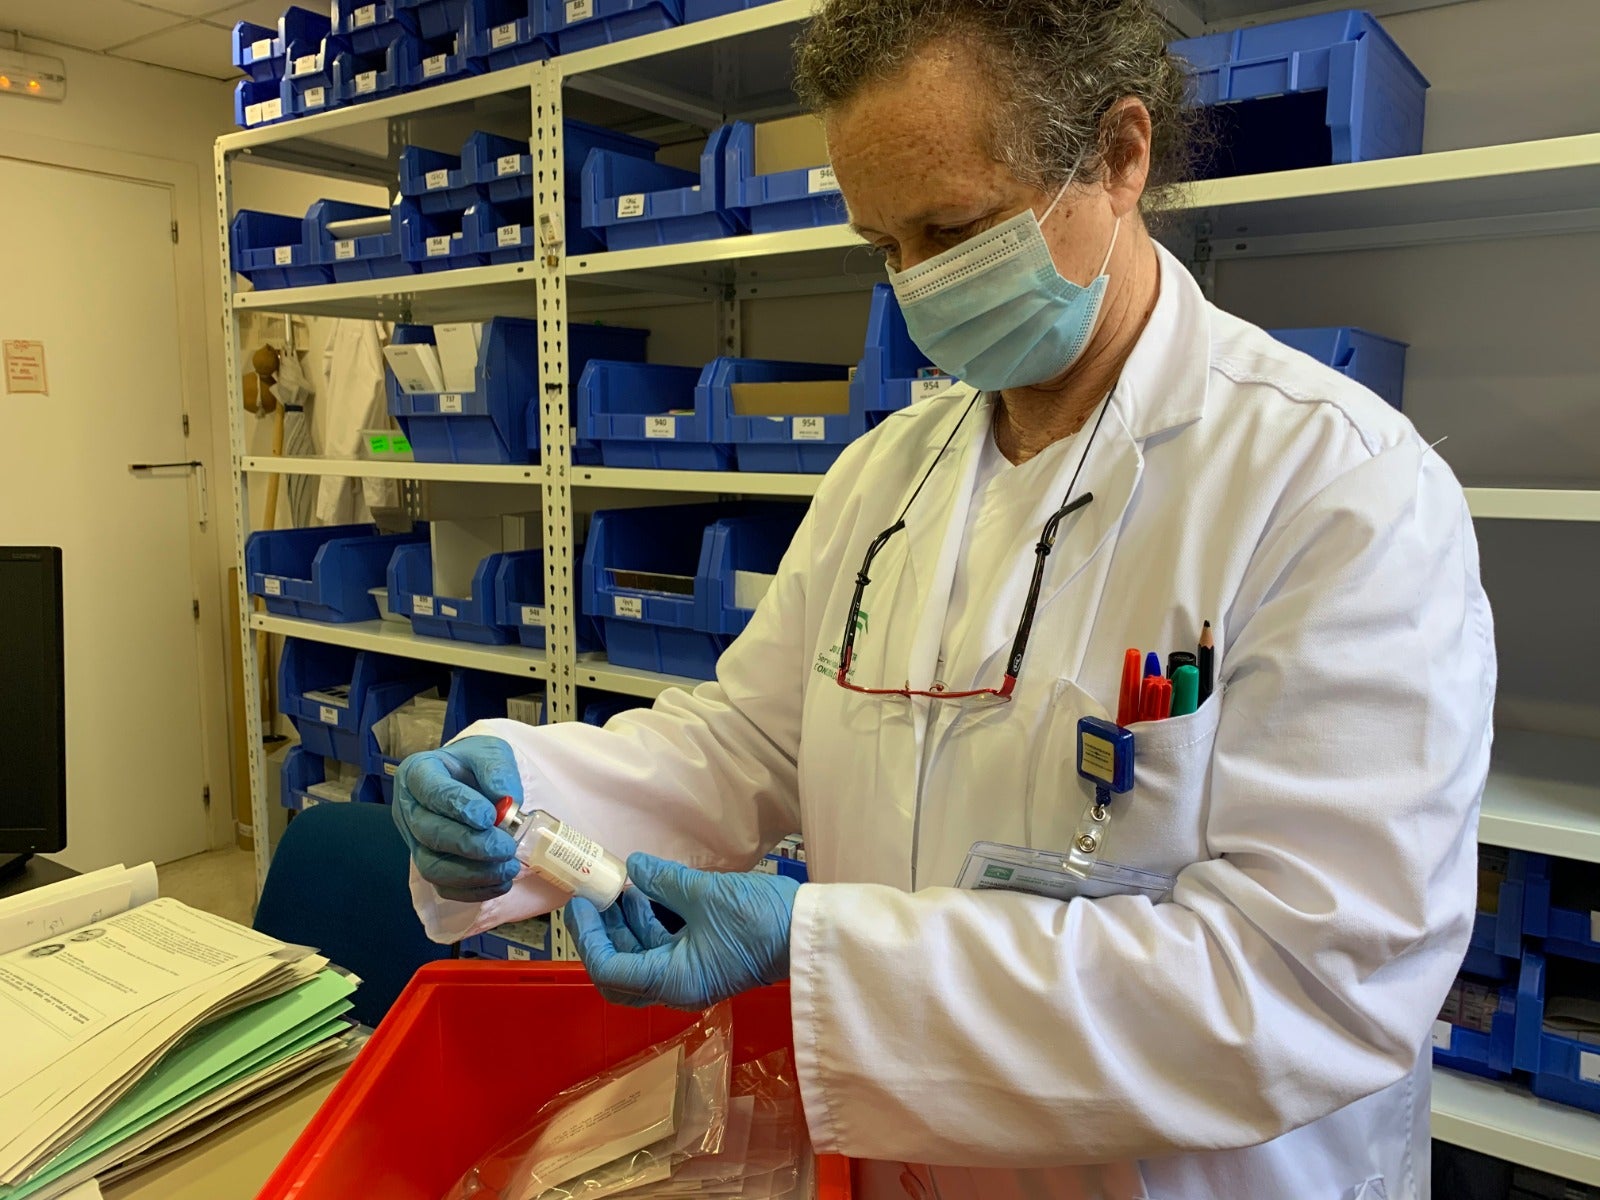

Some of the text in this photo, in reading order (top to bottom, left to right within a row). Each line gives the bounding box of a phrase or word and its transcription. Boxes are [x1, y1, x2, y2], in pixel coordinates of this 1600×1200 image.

[922, 381, 939, 391] 954
[654, 418, 667, 426] 940
[801, 418, 816, 427] 954
